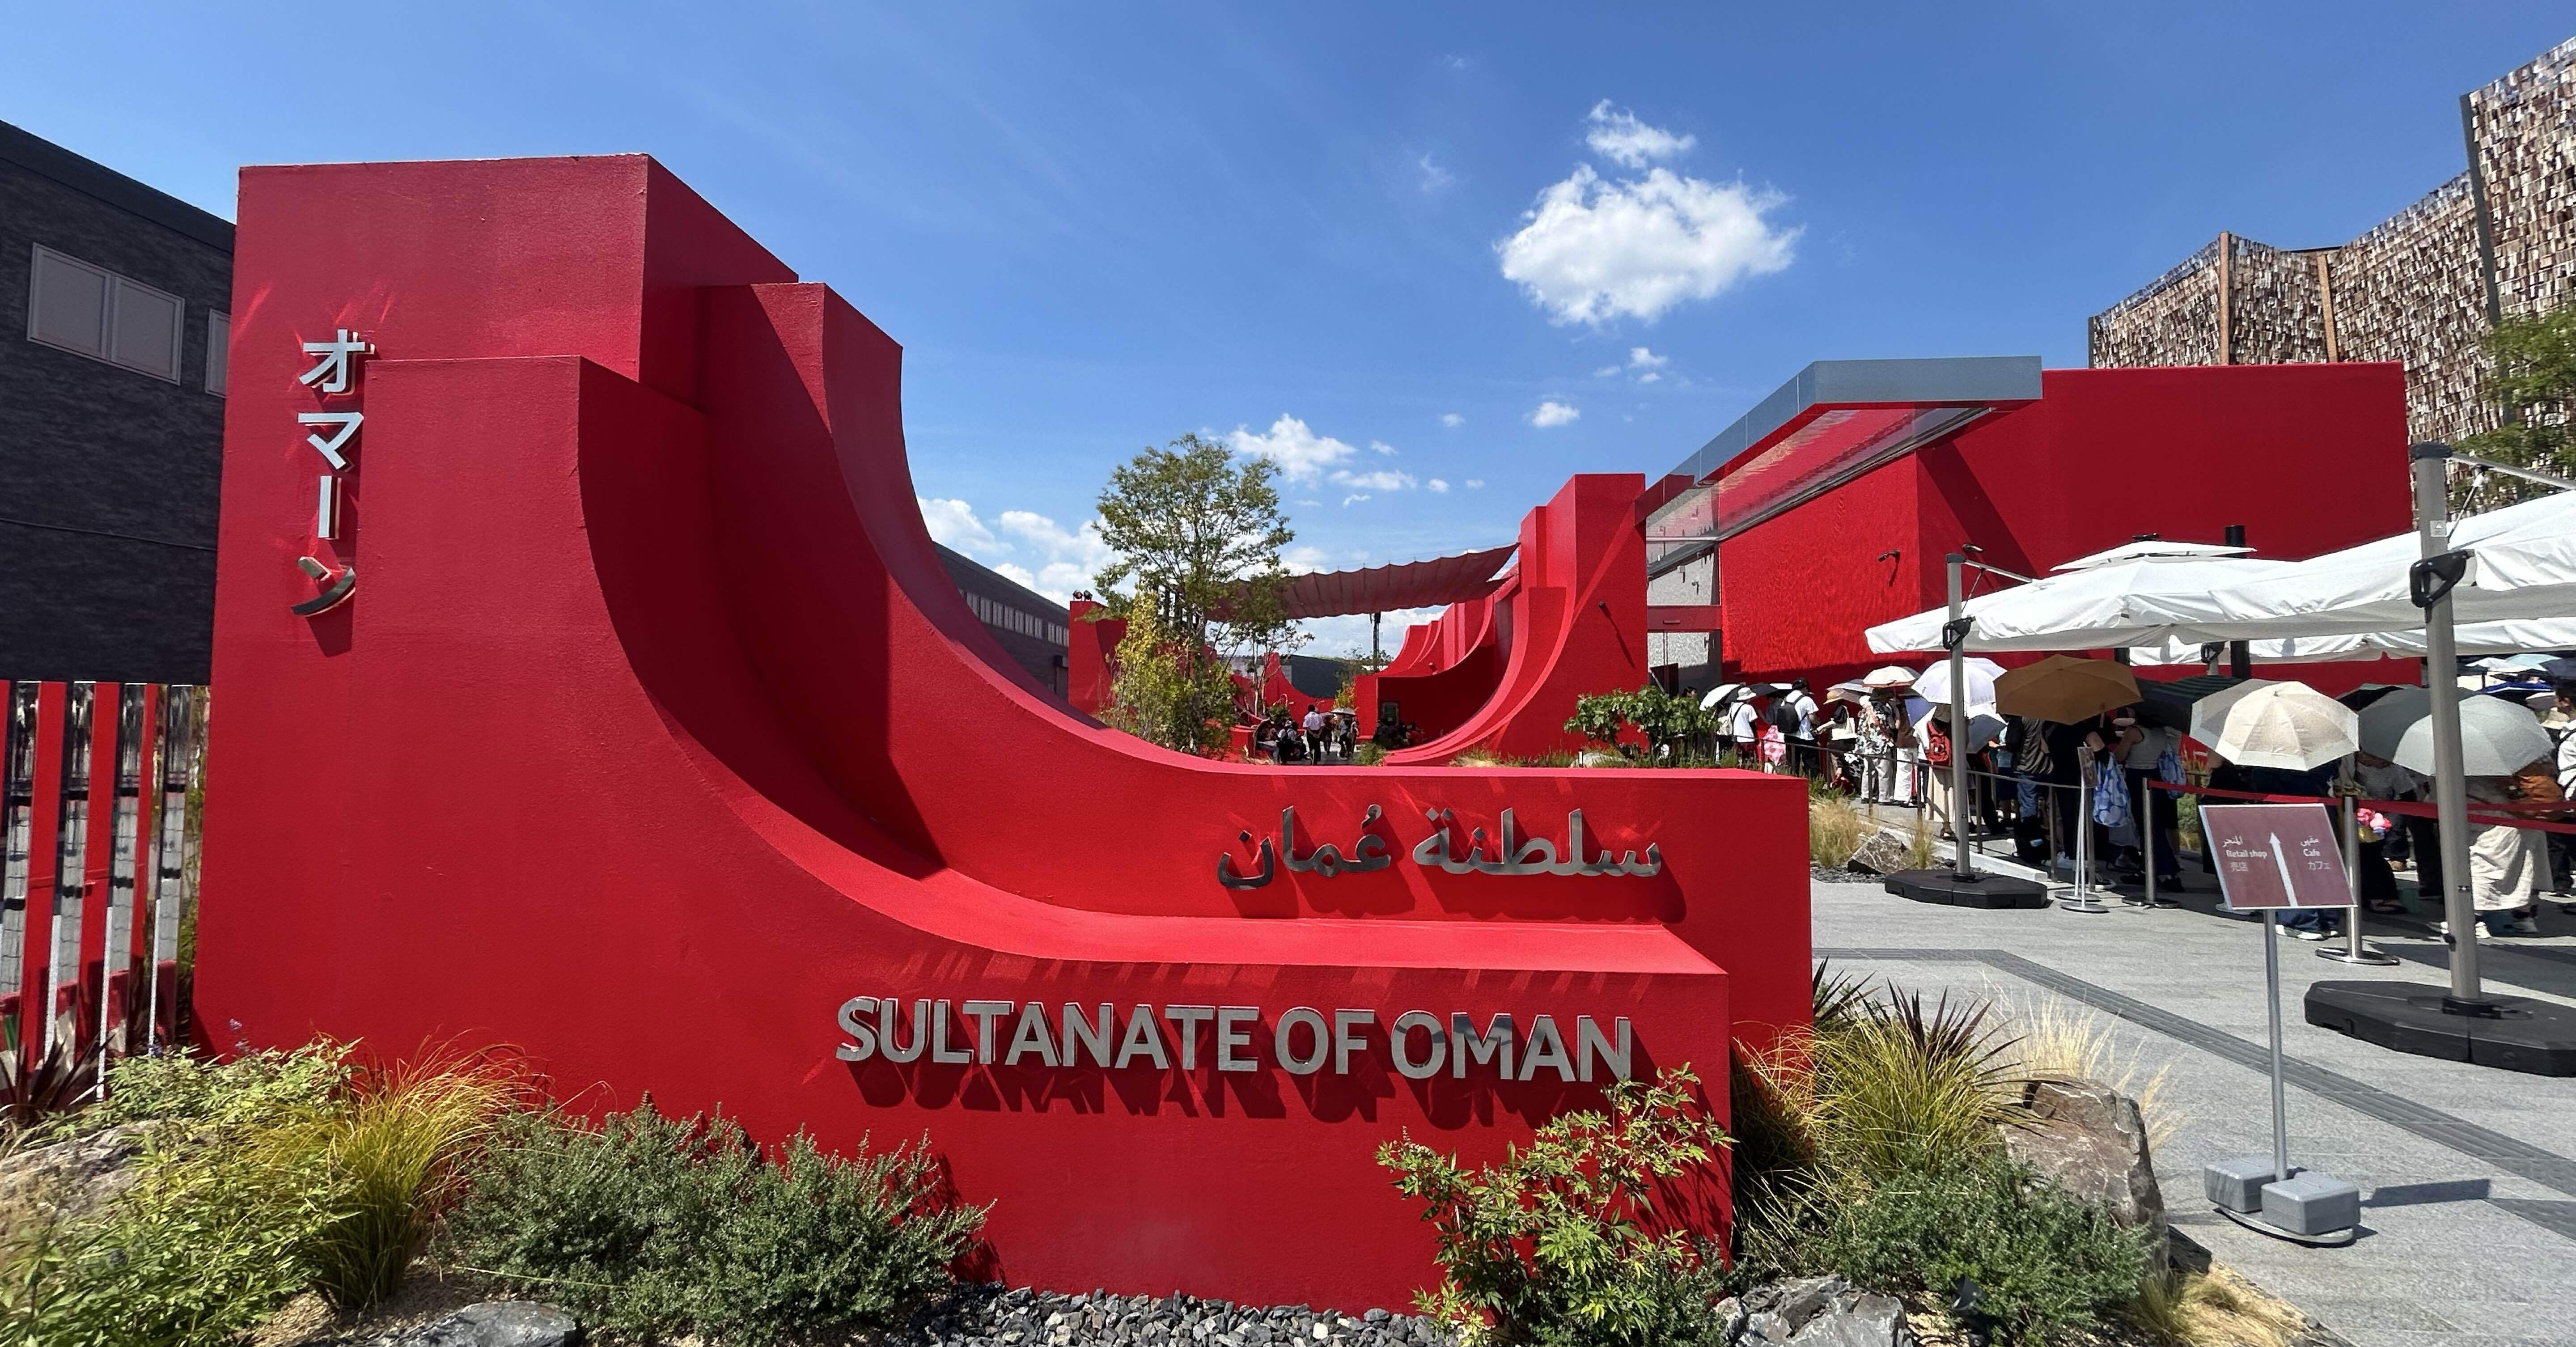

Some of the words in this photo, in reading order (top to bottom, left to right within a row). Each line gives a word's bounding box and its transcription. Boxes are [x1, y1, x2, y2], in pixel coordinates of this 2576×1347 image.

[291, 329, 375, 616] オマーン
[1413, 807, 1662, 877] سلطنة
[2249, 850, 2267, 859] shop
[2229, 861, 2248, 872] 売店
[2307, 860, 2330, 871] カフェ
[835, 996, 1260, 1072] SULTANATE
[1275, 1006, 1375, 1074] OF
[1391, 1010, 1631, 1082] OMAN
